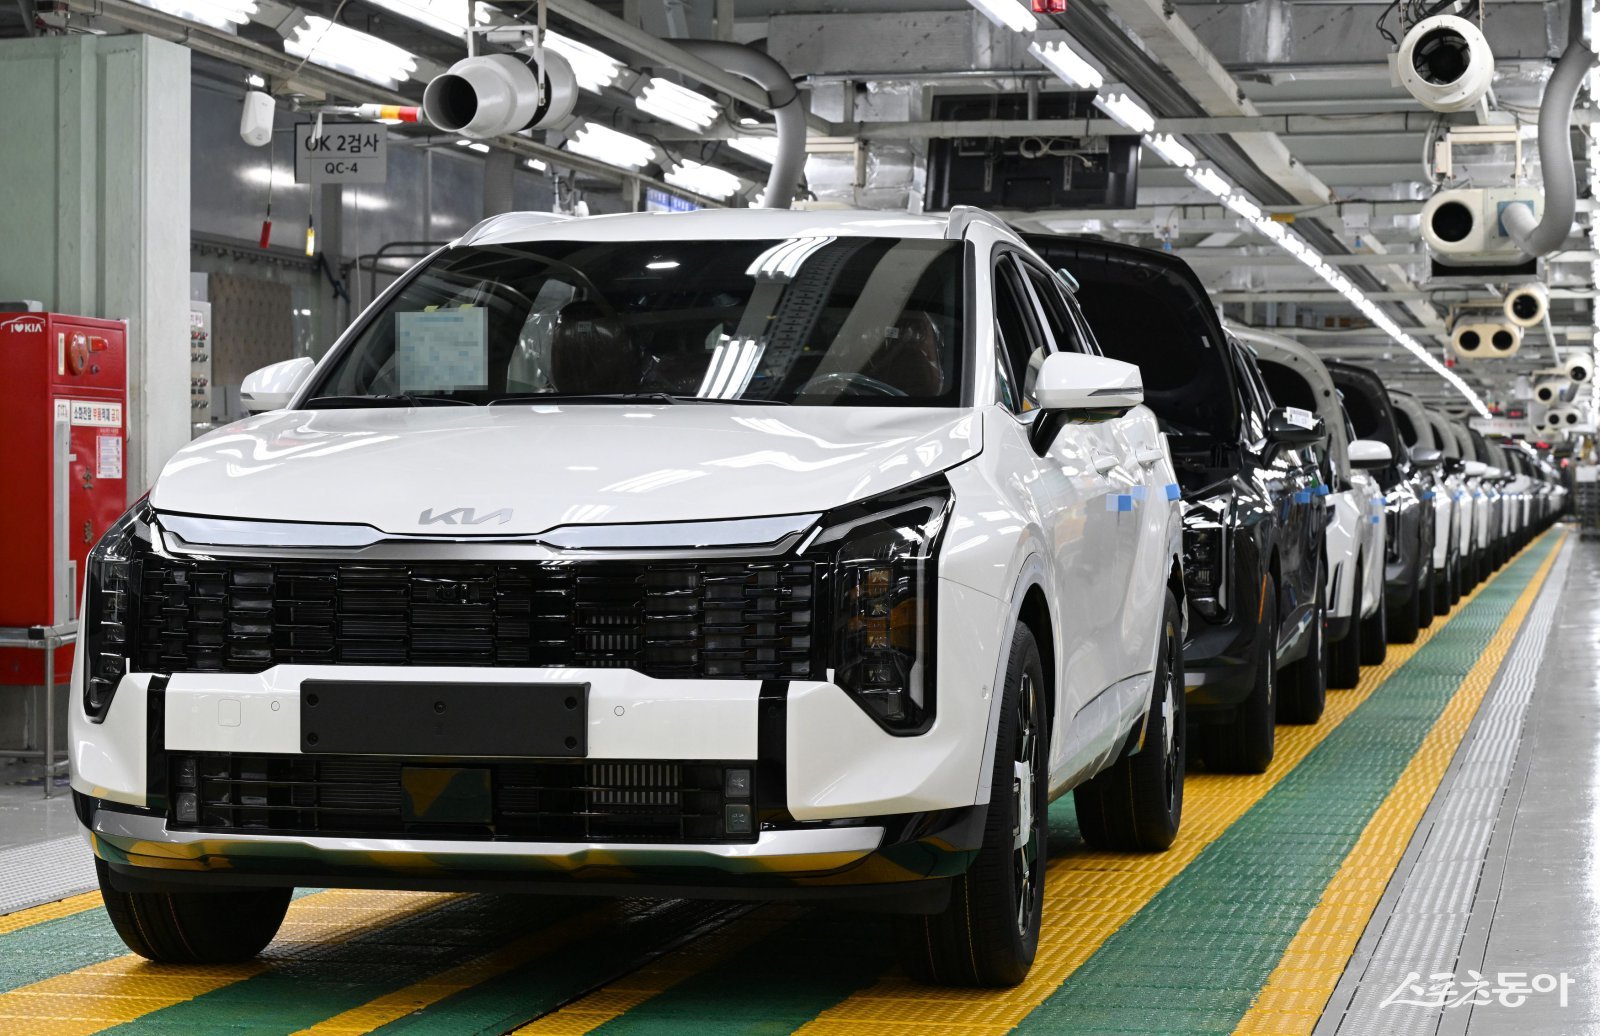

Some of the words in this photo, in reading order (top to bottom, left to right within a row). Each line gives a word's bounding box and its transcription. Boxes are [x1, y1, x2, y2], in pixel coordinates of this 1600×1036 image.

[305, 134, 331, 152] OK
[337, 133, 379, 153] 2검사
[325, 162, 358, 175] QC-4
[25, 323, 42, 333] KIA
[418, 507, 514, 525] KIA
